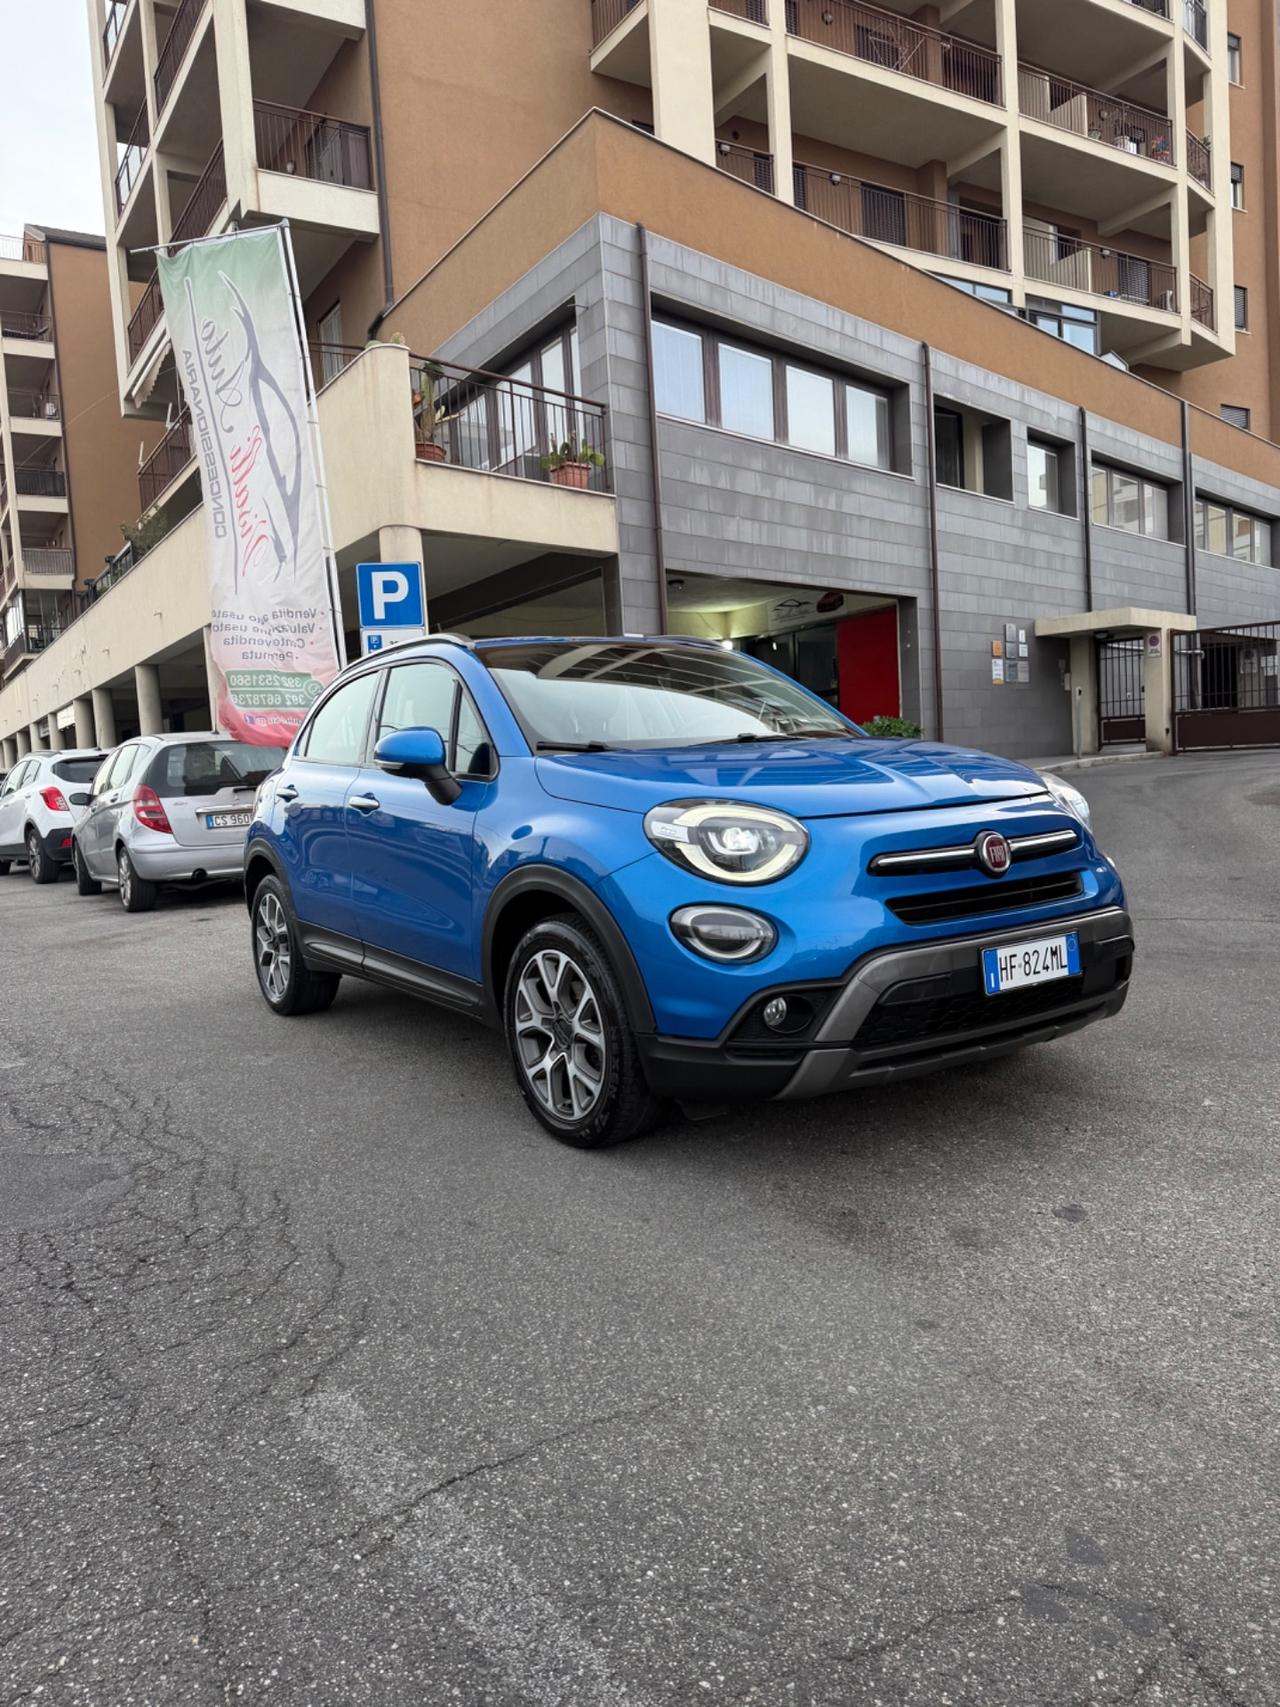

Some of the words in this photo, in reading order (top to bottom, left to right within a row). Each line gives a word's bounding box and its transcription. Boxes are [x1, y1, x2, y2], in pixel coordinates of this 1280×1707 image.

[371, 571, 409, 620] P
[214, 815, 228, 826] CS
[230, 813, 252, 825] 960
